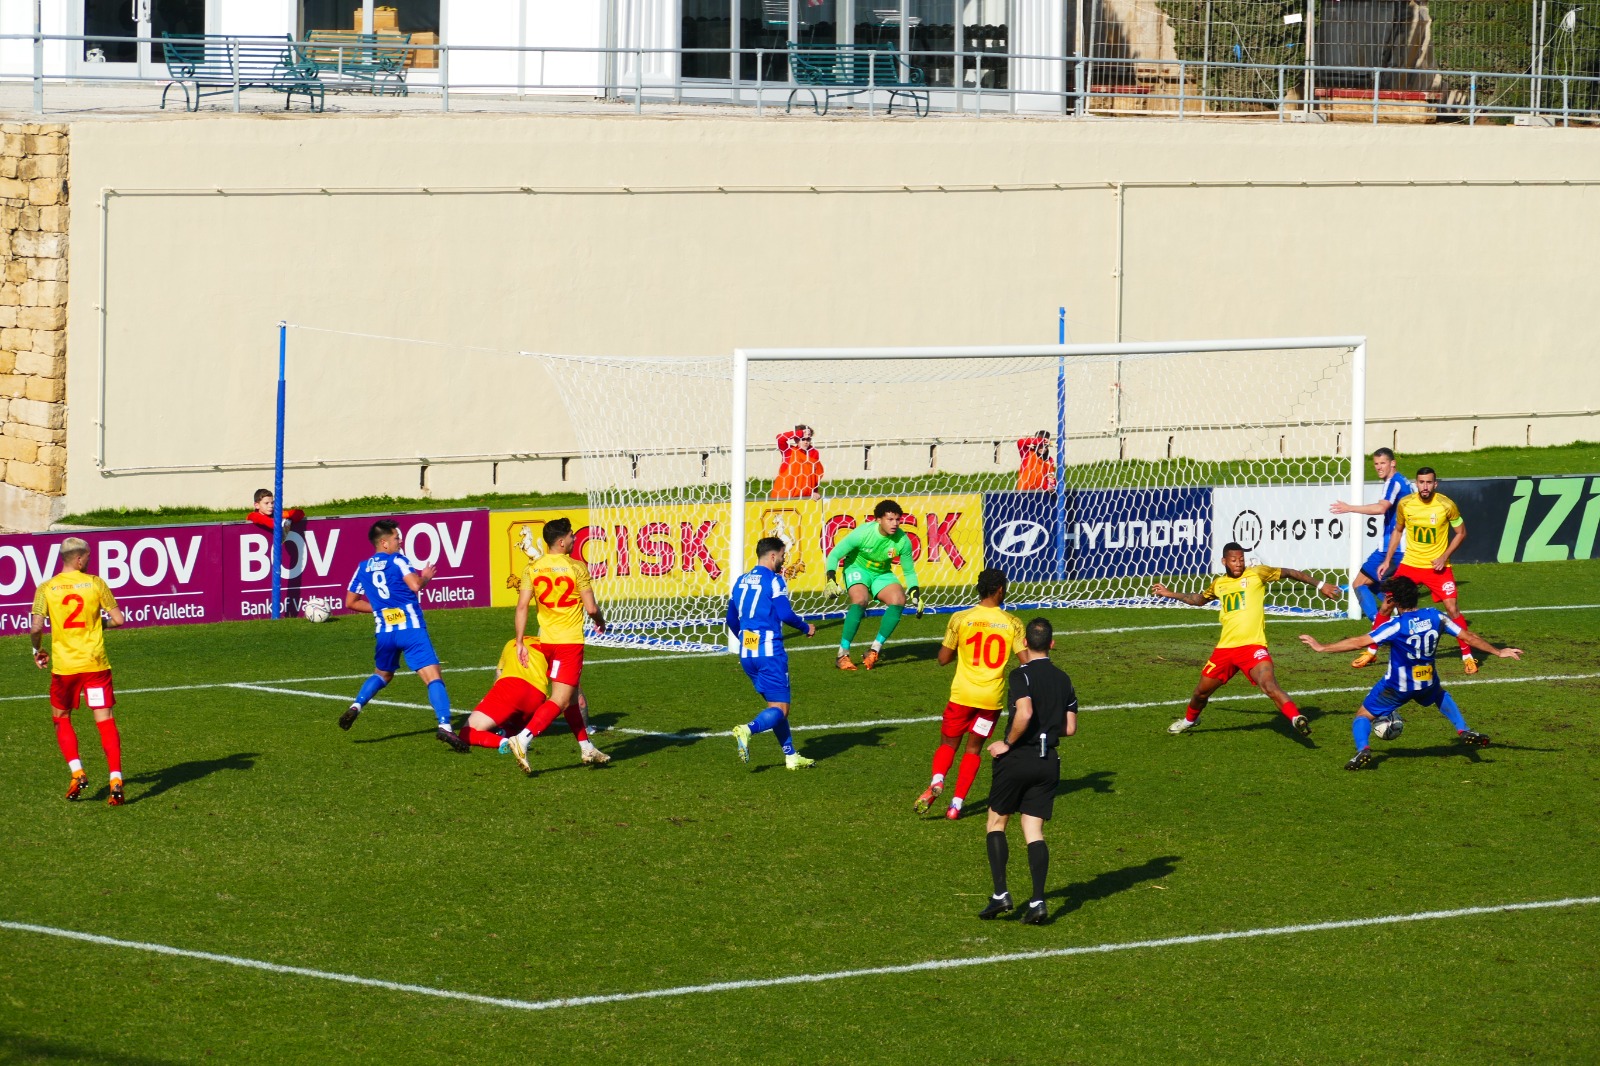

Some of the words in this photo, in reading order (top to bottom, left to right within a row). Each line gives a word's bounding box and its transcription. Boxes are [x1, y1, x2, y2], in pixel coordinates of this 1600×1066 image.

[396, 520, 472, 571] OV
[820, 512, 966, 571] CSK
[1064, 518, 1204, 550] HYUNDAI
[1270, 517, 1377, 541] MOTOS
[98, 535, 202, 589] BOV
[239, 529, 340, 582] BOV
[569, 520, 722, 580] CISK
[0, 543, 61, 595] OV
[372, 570, 391, 600] 8
[847, 571, 862, 583] 19
[241, 598, 273, 616] Bank
[293, 595, 343, 612] Vata
[426, 586, 475, 603] Valletta
[533, 575, 578, 609] 22
[738, 583, 763, 619] 77
[61, 593, 86, 630] 2
[135, 604, 150, 621] of
[152, 602, 205, 620] Valletta
[965, 631, 1007, 670] 10
[1406, 629, 1439, 660] 30
